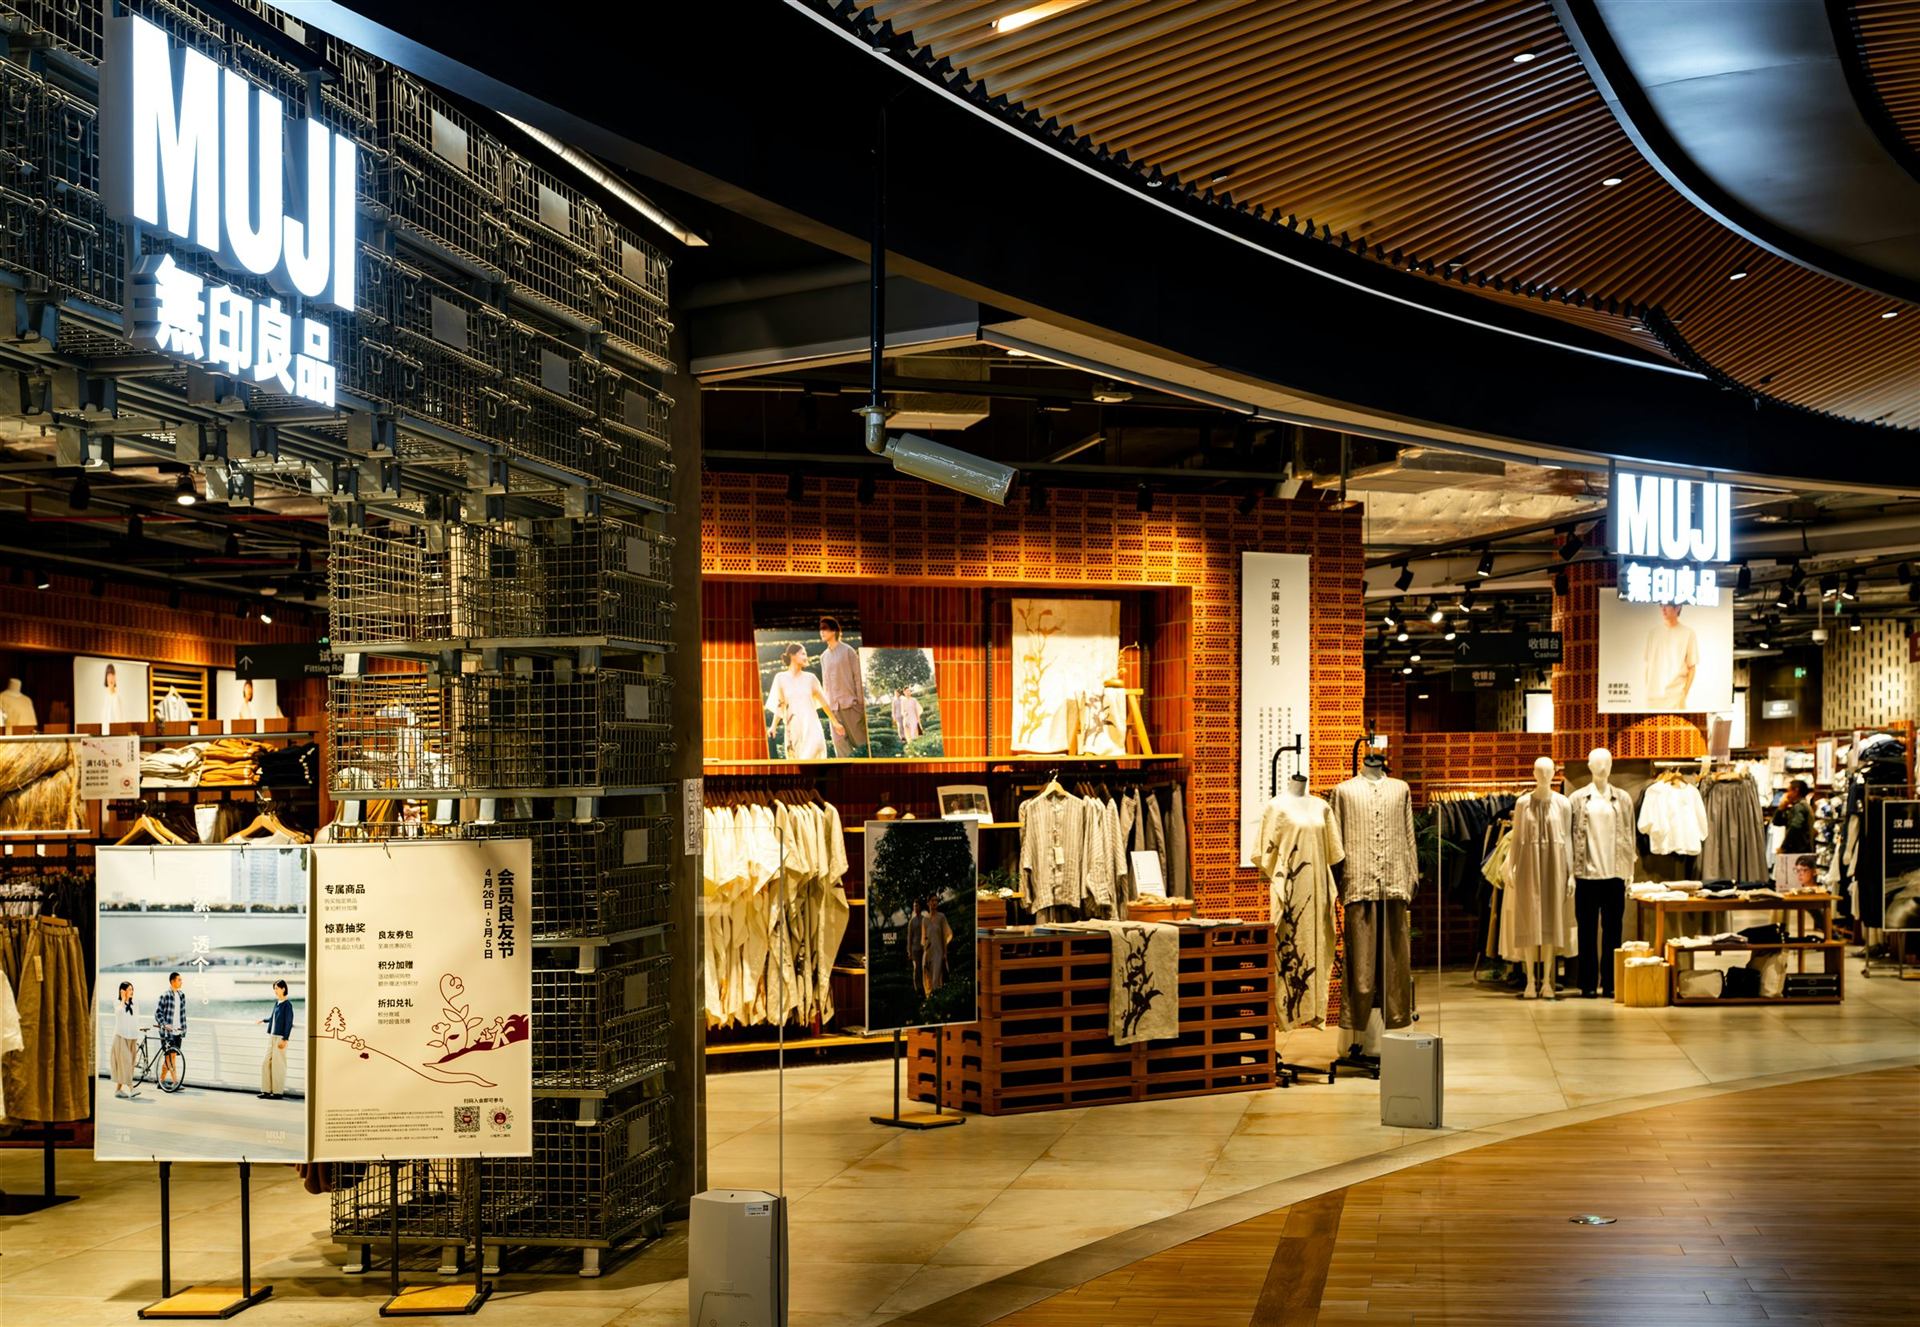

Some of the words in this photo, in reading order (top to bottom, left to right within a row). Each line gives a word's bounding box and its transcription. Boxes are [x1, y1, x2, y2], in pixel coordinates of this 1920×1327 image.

[132, 15, 356, 312] MUJI
[155, 253, 335, 407] 無印良品
[1618, 472, 1731, 562] MUJI
[1622, 561, 1720, 607] 無印良品
[1271, 578, 1280, 666] 汉麻设计师系列
[1528, 638, 1559, 650] 收银台
[1534, 651, 1559, 659] Cashier
[304, 665, 330, 673] Fitting
[324, 884, 366, 895] 专属商品
[497, 868, 515, 959] 会员良友节
[324, 922, 366, 934] 惊喜抽奖
[378, 930, 414, 940] 良友券包
[378, 960, 413, 970] 积分加赠
[378, 998, 414, 1008] 折扣兑礼
